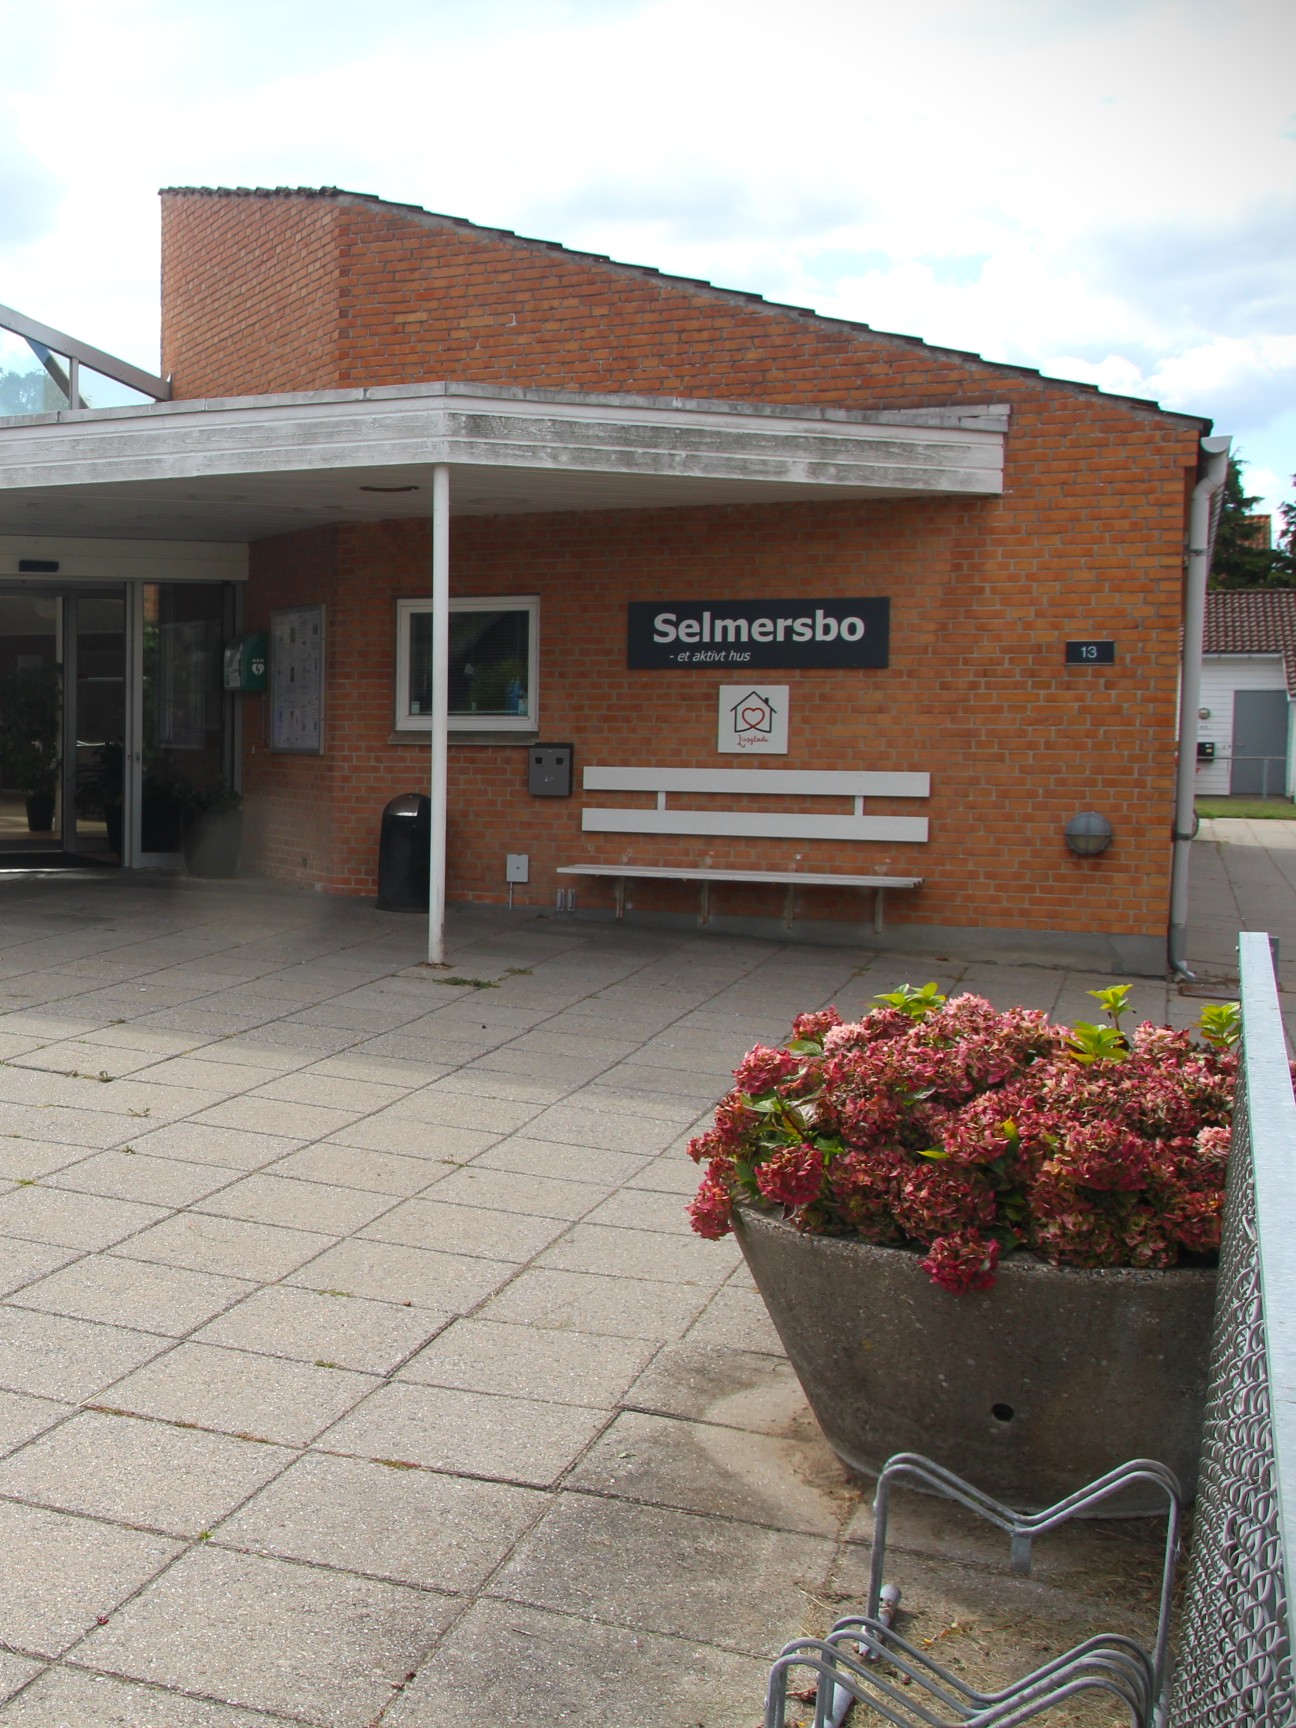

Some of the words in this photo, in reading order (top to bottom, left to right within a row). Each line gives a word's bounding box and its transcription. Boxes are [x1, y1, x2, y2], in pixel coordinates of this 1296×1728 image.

[653, 609, 865, 643] Selmersbo
[677, 651, 690, 661] et
[692, 650, 726, 661] aktivt
[728, 650, 751, 661] hus
[1080, 646, 1097, 658] 13
